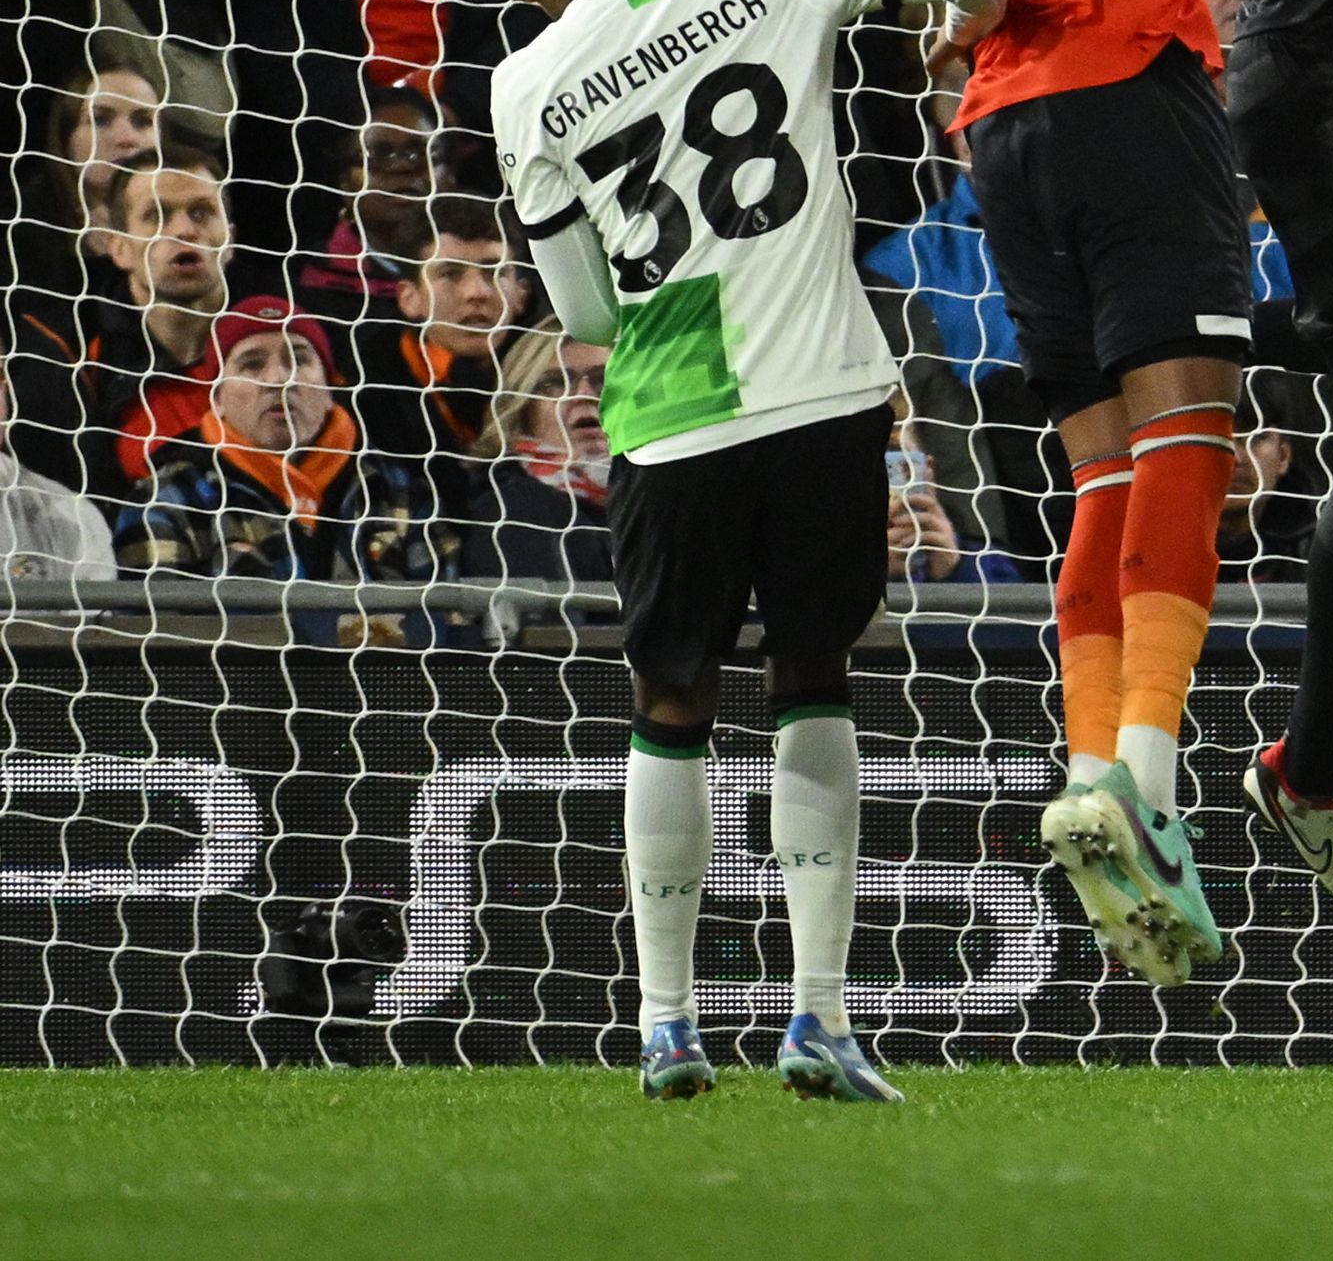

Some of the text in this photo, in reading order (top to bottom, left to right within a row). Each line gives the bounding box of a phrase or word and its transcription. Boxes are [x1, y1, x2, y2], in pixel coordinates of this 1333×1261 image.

[574, 61, 809, 293] 38
[776, 851, 832, 867] LFC
[640, 879, 698, 899] LFC
